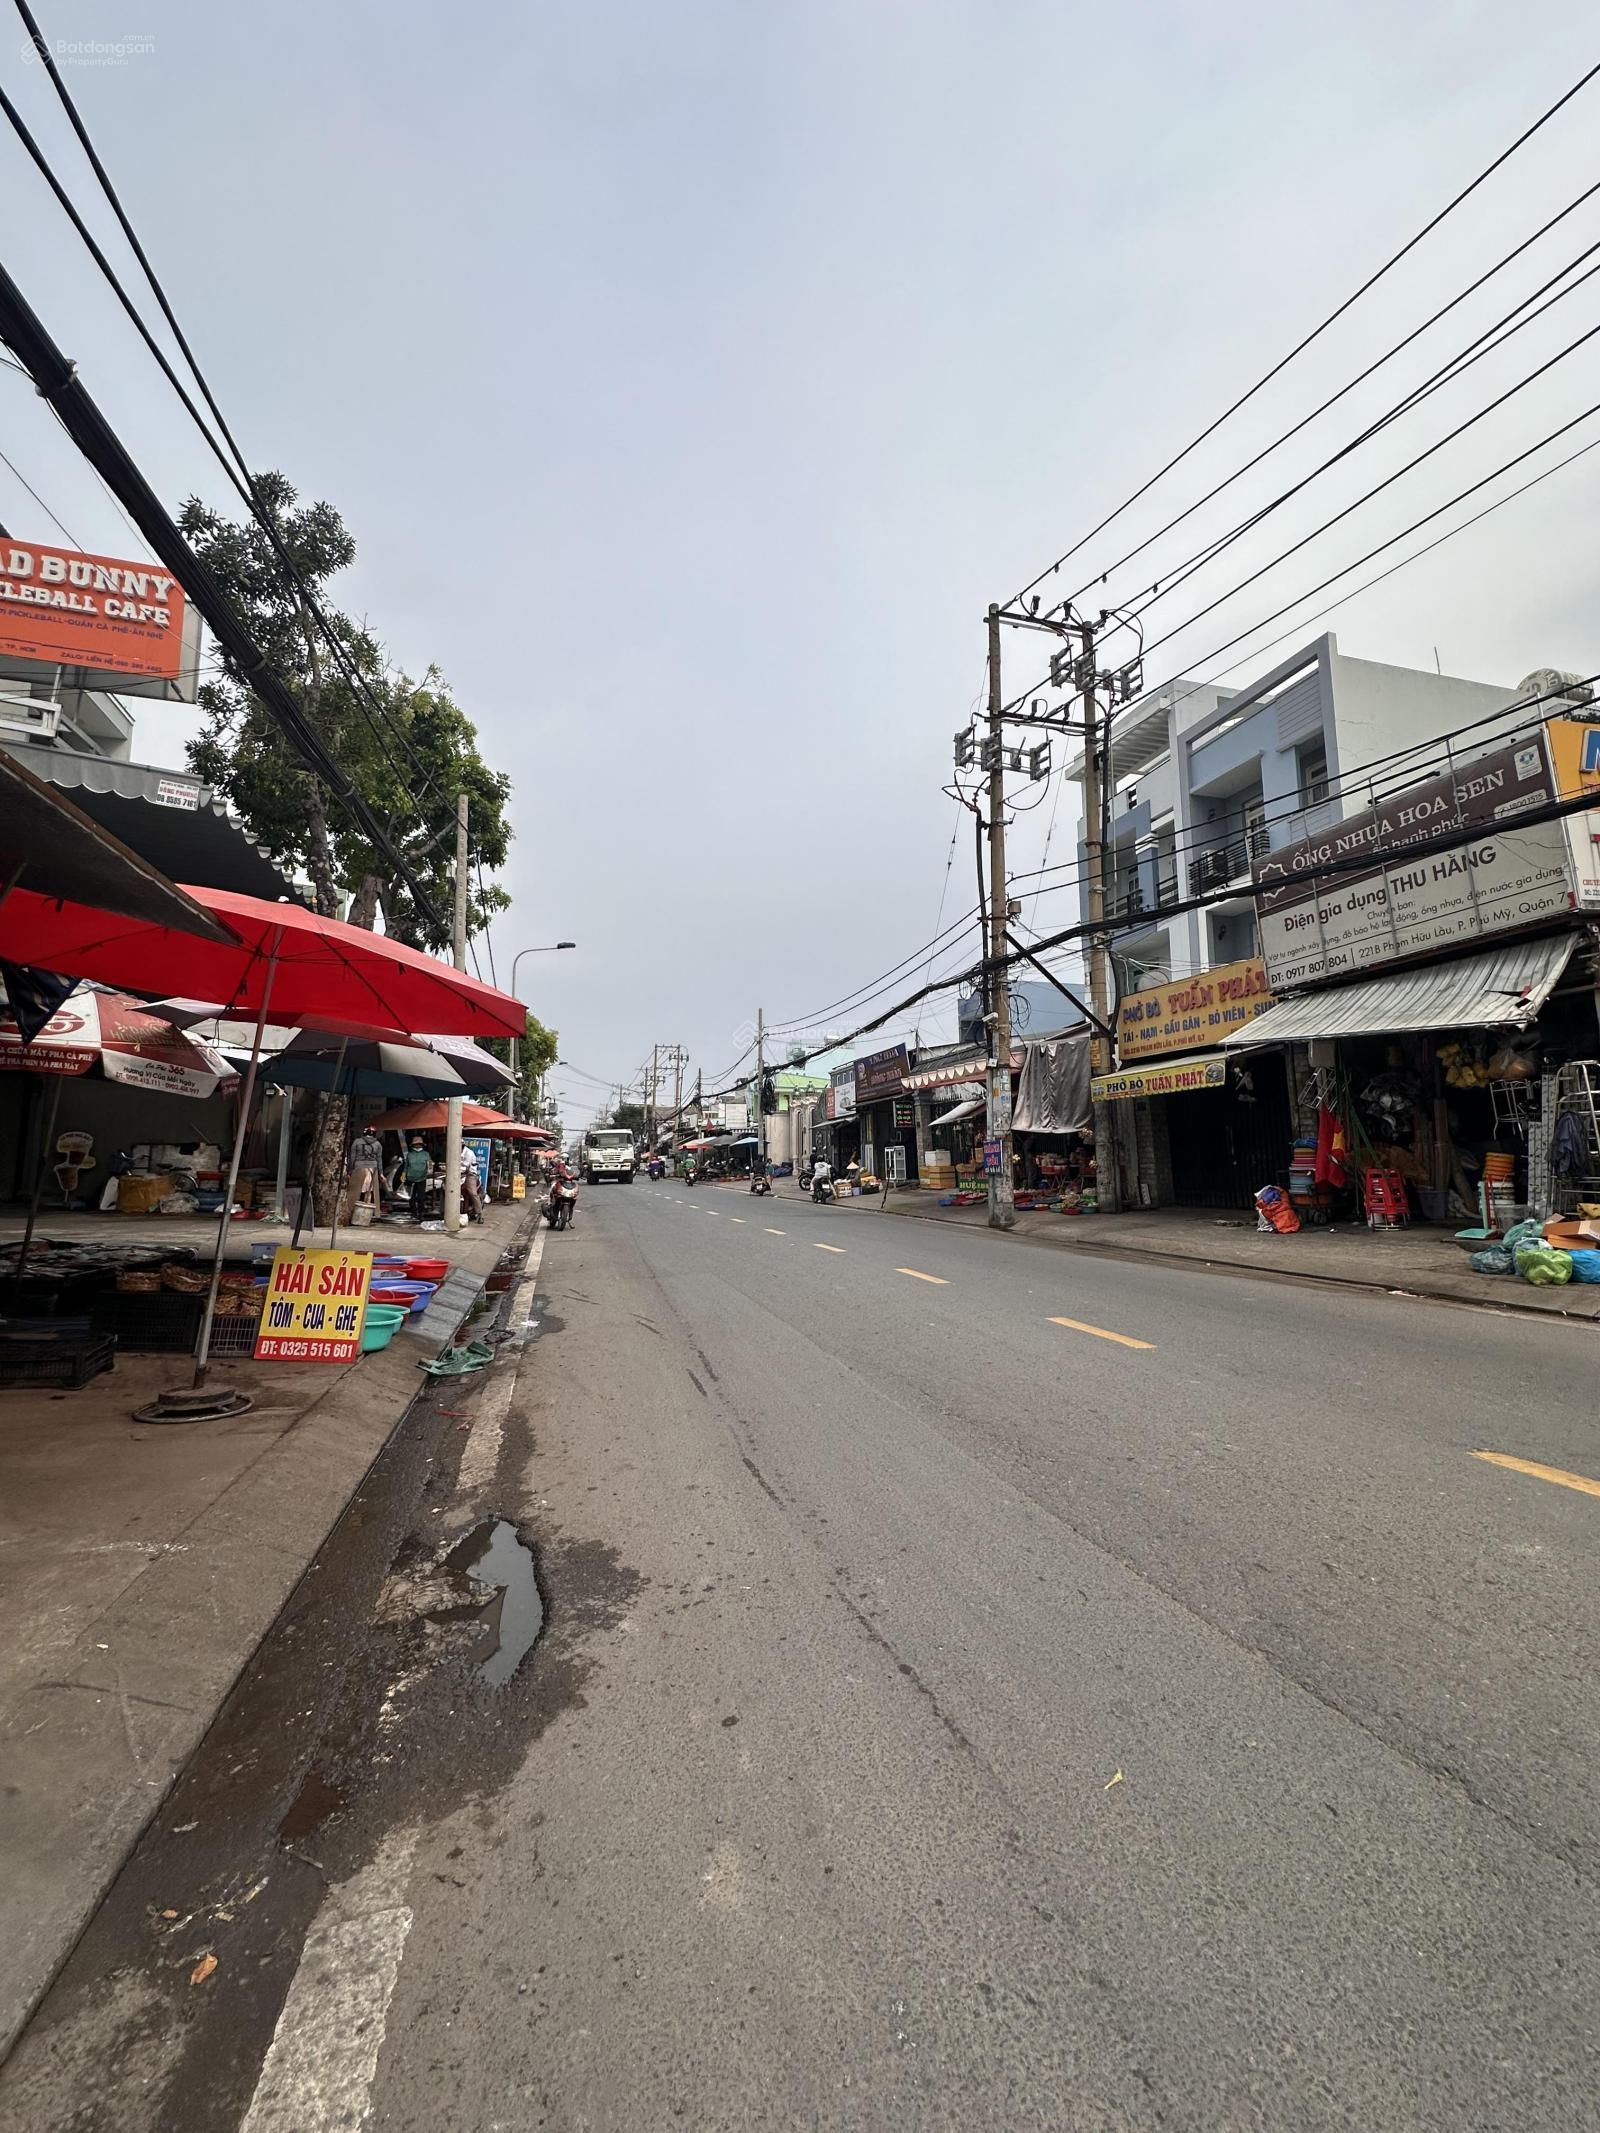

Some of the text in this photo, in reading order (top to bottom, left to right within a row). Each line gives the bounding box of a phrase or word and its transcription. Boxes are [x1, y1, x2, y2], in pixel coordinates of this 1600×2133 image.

[40, 555, 176, 602] BUNNY
[104, 599, 171, 628] CAFE
[1397, 796, 1449, 828] HOA
[1455, 769, 1504, 803] SEN
[1284, 912, 1315, 932] Điện
[1319, 902, 1342, 924] gia
[1347, 888, 1387, 910] dụng
[1390, 868, 1427, 895] THU
[1515, 874, 1532, 889] gia
[1359, 944, 1380, 959] 221B
[1458, 920, 1467, 932] P.
[1518, 898, 1554, 914] Quận
[1558, 891, 1566, 904] 7
[1271, 955, 1347, 984] ĐT: 0917 807 804
[1168, 979, 1214, 1014] TUẤN
[1217, 967, 1268, 1002] PHÁT
[1123, 1028, 1134, 1044] TÁI
[1223, 1003, 1246, 1022] VIÊN
[168, 1064, 185, 1076] 365
[1107, 1067, 1204, 1092] PHỞ BÒ TUẤN PHÁT
[274, 1254, 366, 1297] HẢI SẢN
[268, 1296, 359, 1337] TÔM CUA GHẸ
[260, 1340, 353, 1359] ĐT: 0325 515 601
